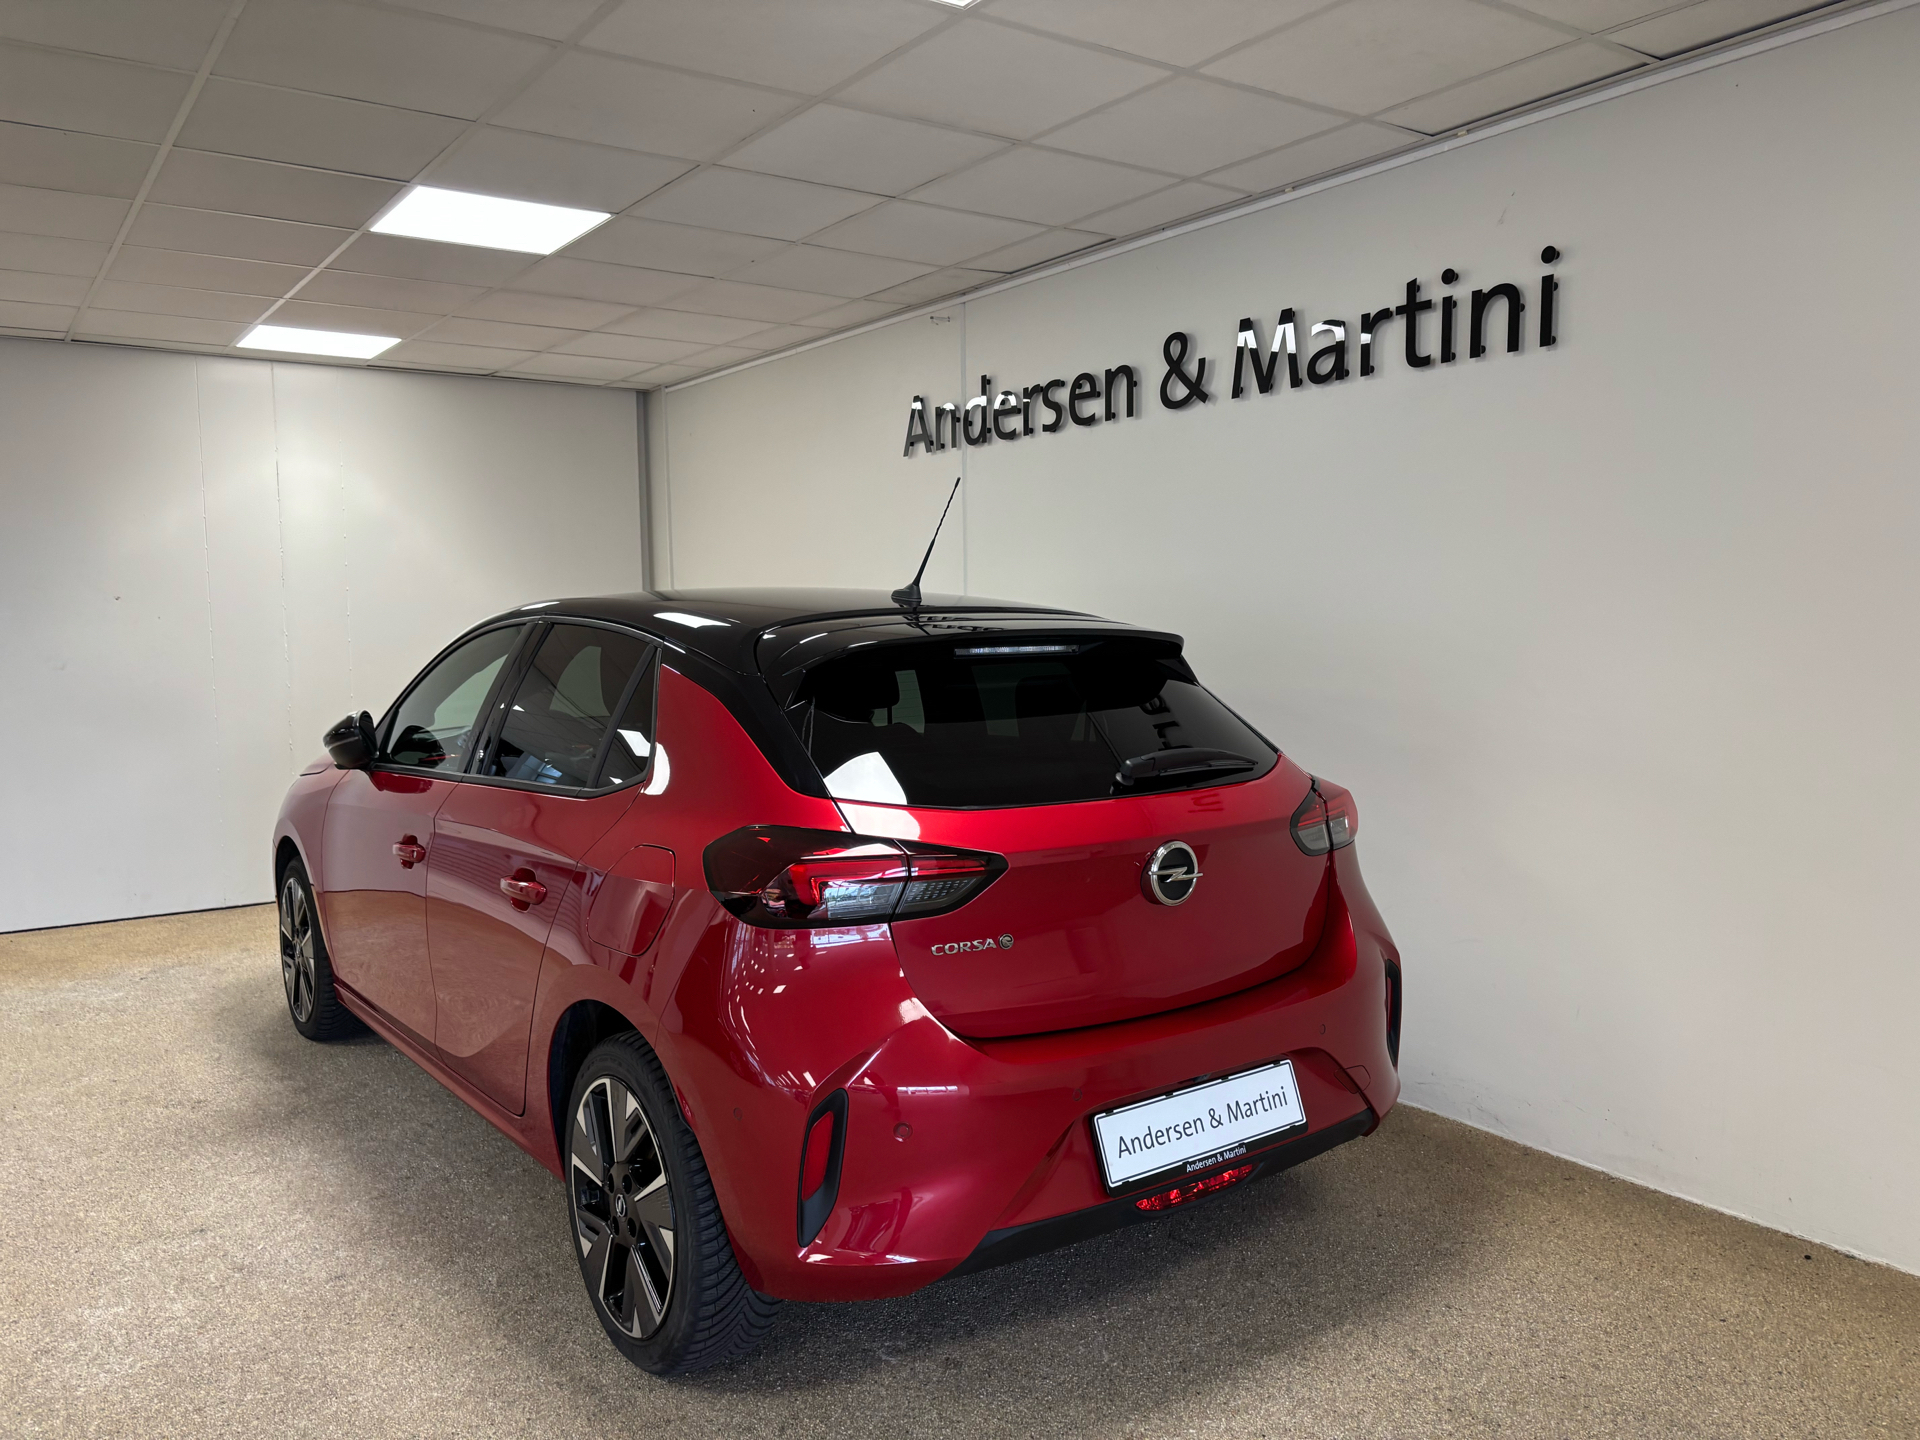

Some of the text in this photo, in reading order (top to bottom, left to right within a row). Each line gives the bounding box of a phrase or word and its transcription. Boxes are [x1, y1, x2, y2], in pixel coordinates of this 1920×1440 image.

[903, 246, 1557, 457] Andersen & Martini
[931, 938, 997, 956] CORSA
[1118, 1086, 1288, 1158] Andersen & Martini
[1186, 1145, 1246, 1172] Andersen & Martini
